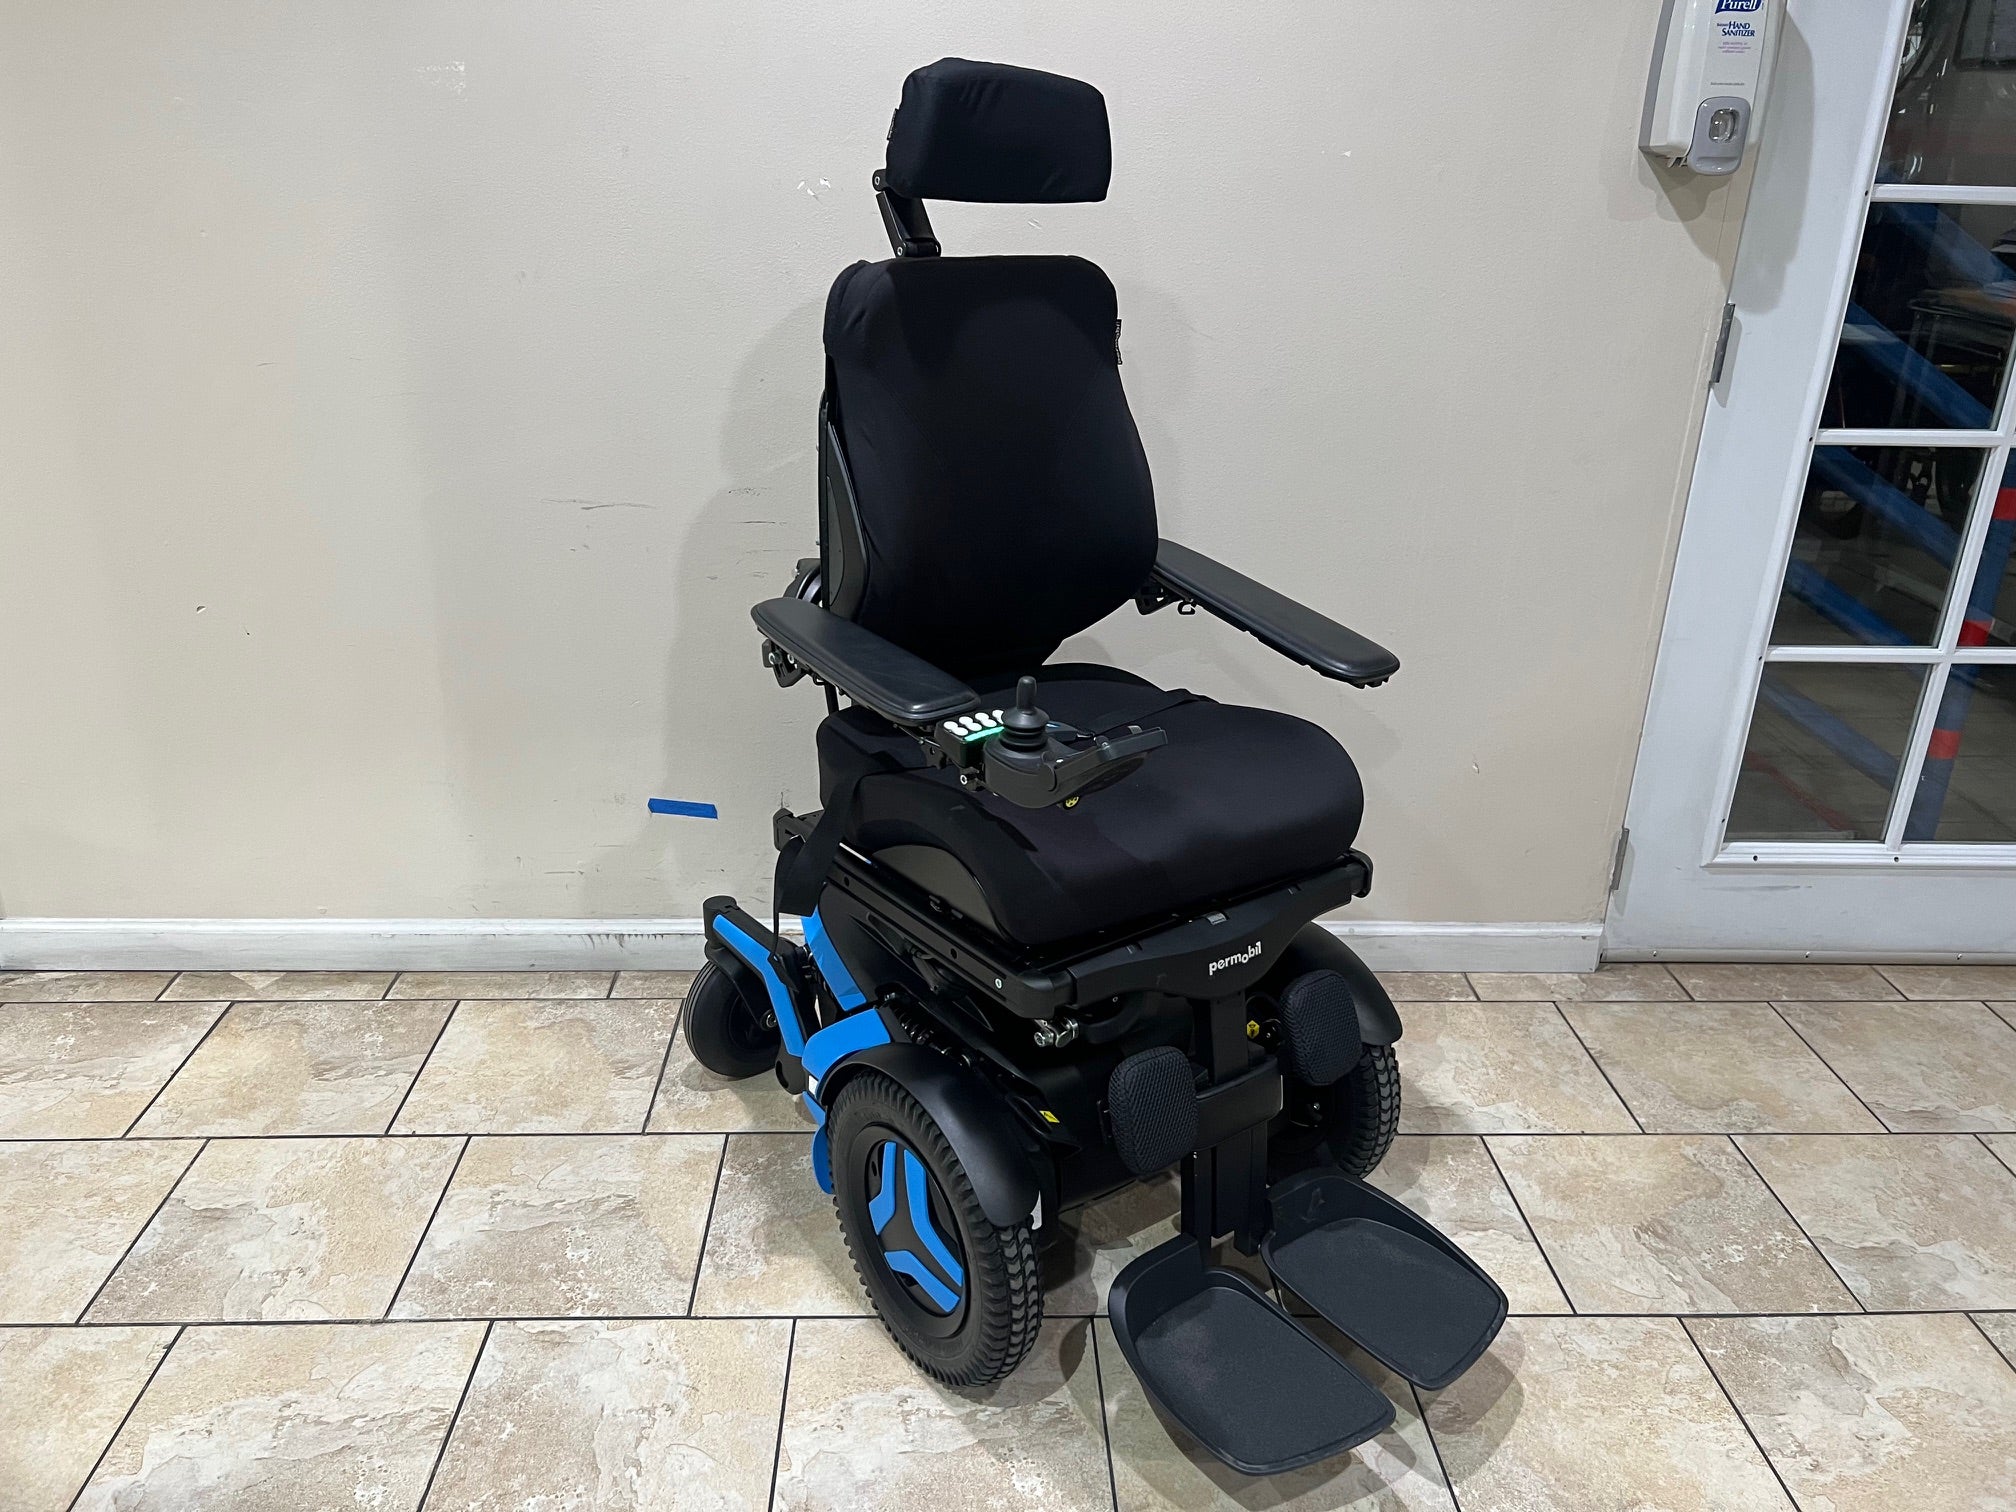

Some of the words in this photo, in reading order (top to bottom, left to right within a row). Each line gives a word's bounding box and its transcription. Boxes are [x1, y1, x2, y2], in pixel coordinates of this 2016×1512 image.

[1729, 21, 1751, 30] HAND
[1721, 28, 1756, 37] SANITIZER
[1208, 940, 1262, 976] permobil
